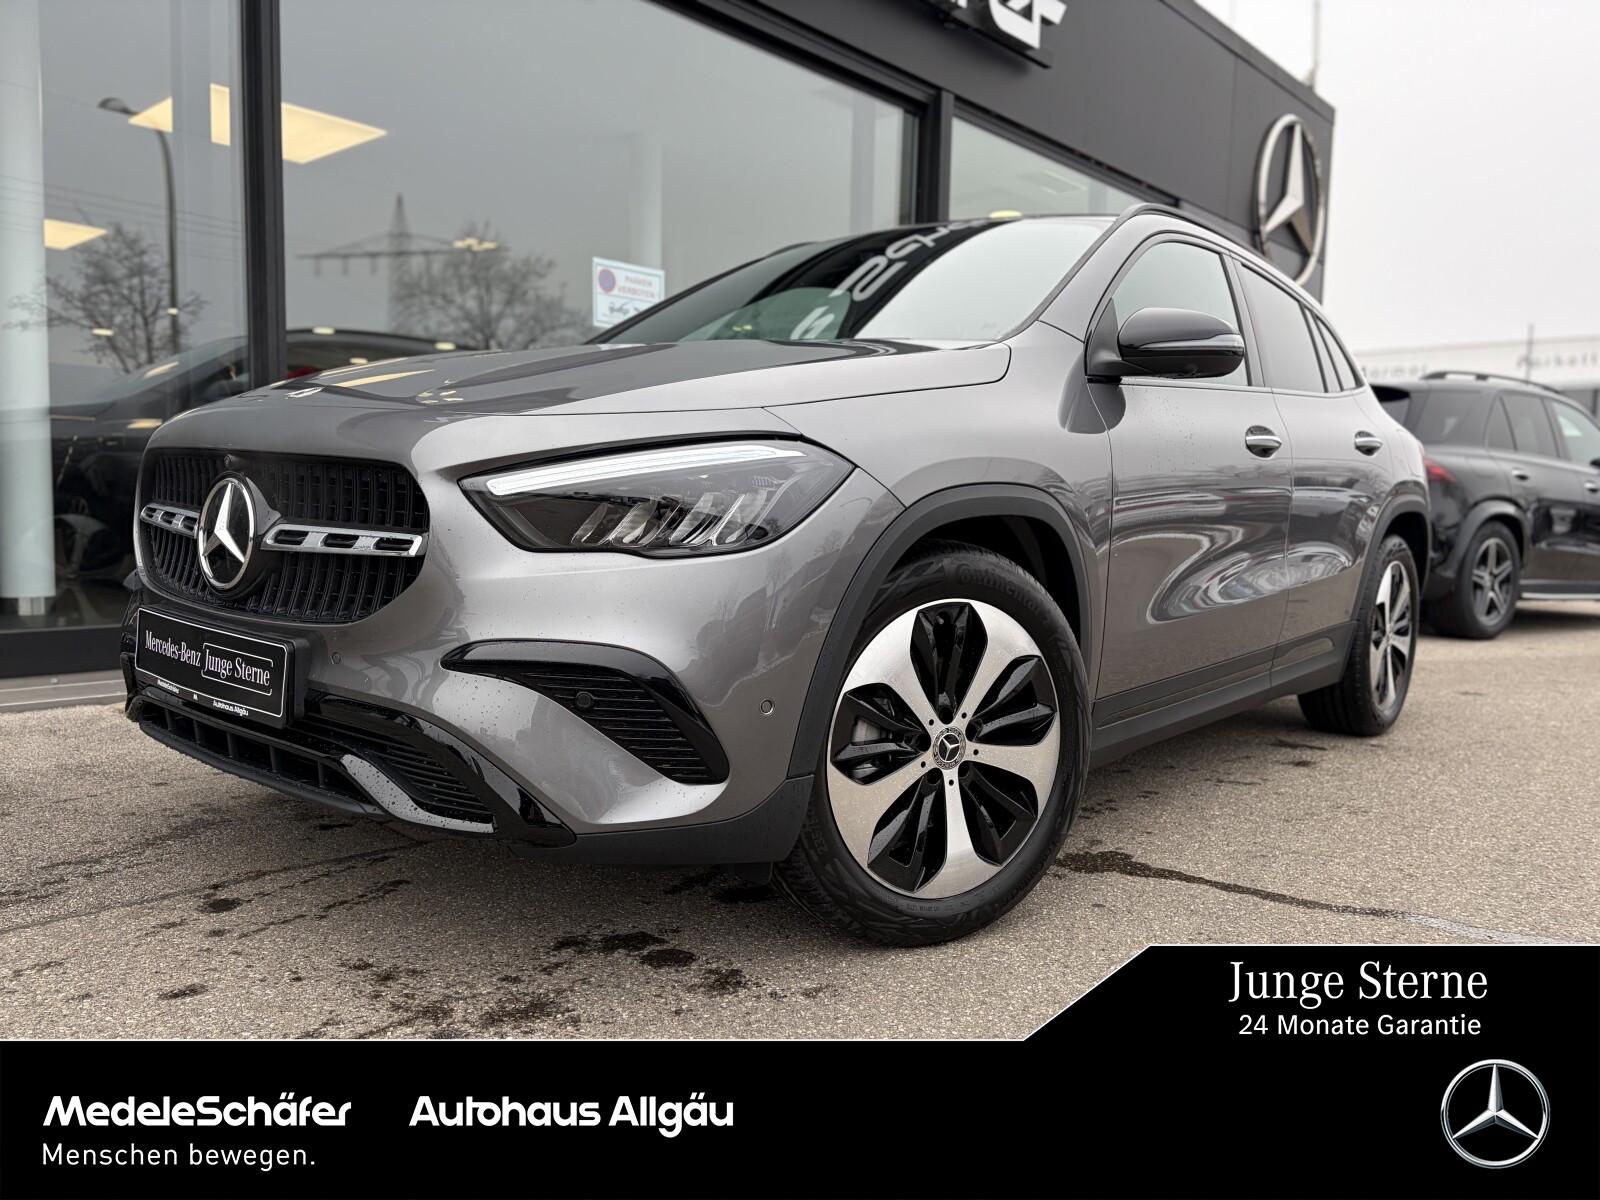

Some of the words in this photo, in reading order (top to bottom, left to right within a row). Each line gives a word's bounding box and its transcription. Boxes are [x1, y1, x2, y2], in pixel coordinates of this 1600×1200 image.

[145, 630, 201, 667] Mercedes-Benz
[204, 649, 233, 678] Junge
[234, 657, 271, 686] Sterne
